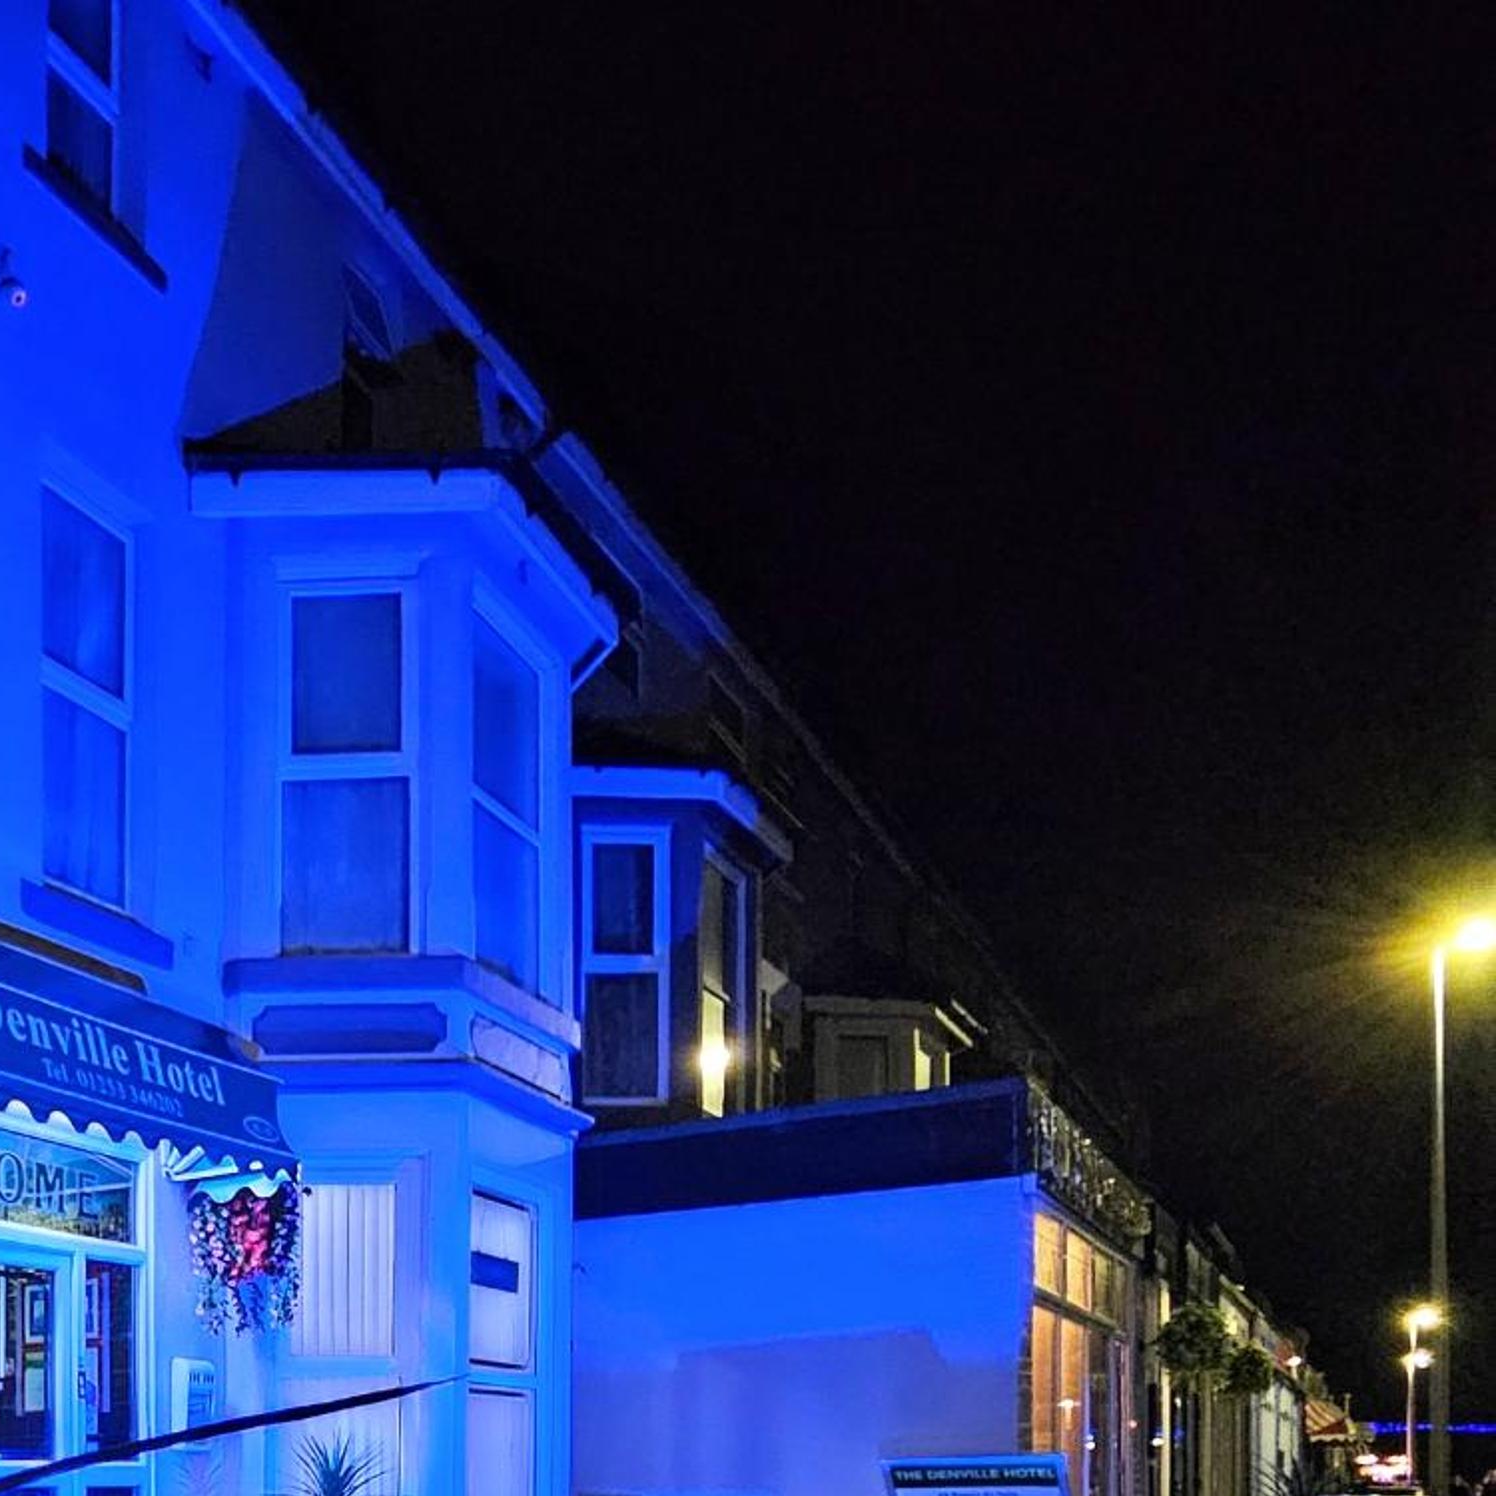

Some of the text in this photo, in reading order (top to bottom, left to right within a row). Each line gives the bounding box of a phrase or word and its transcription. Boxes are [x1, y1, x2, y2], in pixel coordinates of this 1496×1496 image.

[135, 1040, 226, 1105] Hotel
[894, 1467, 1056, 1481] THE DENVILLE HOTEL
